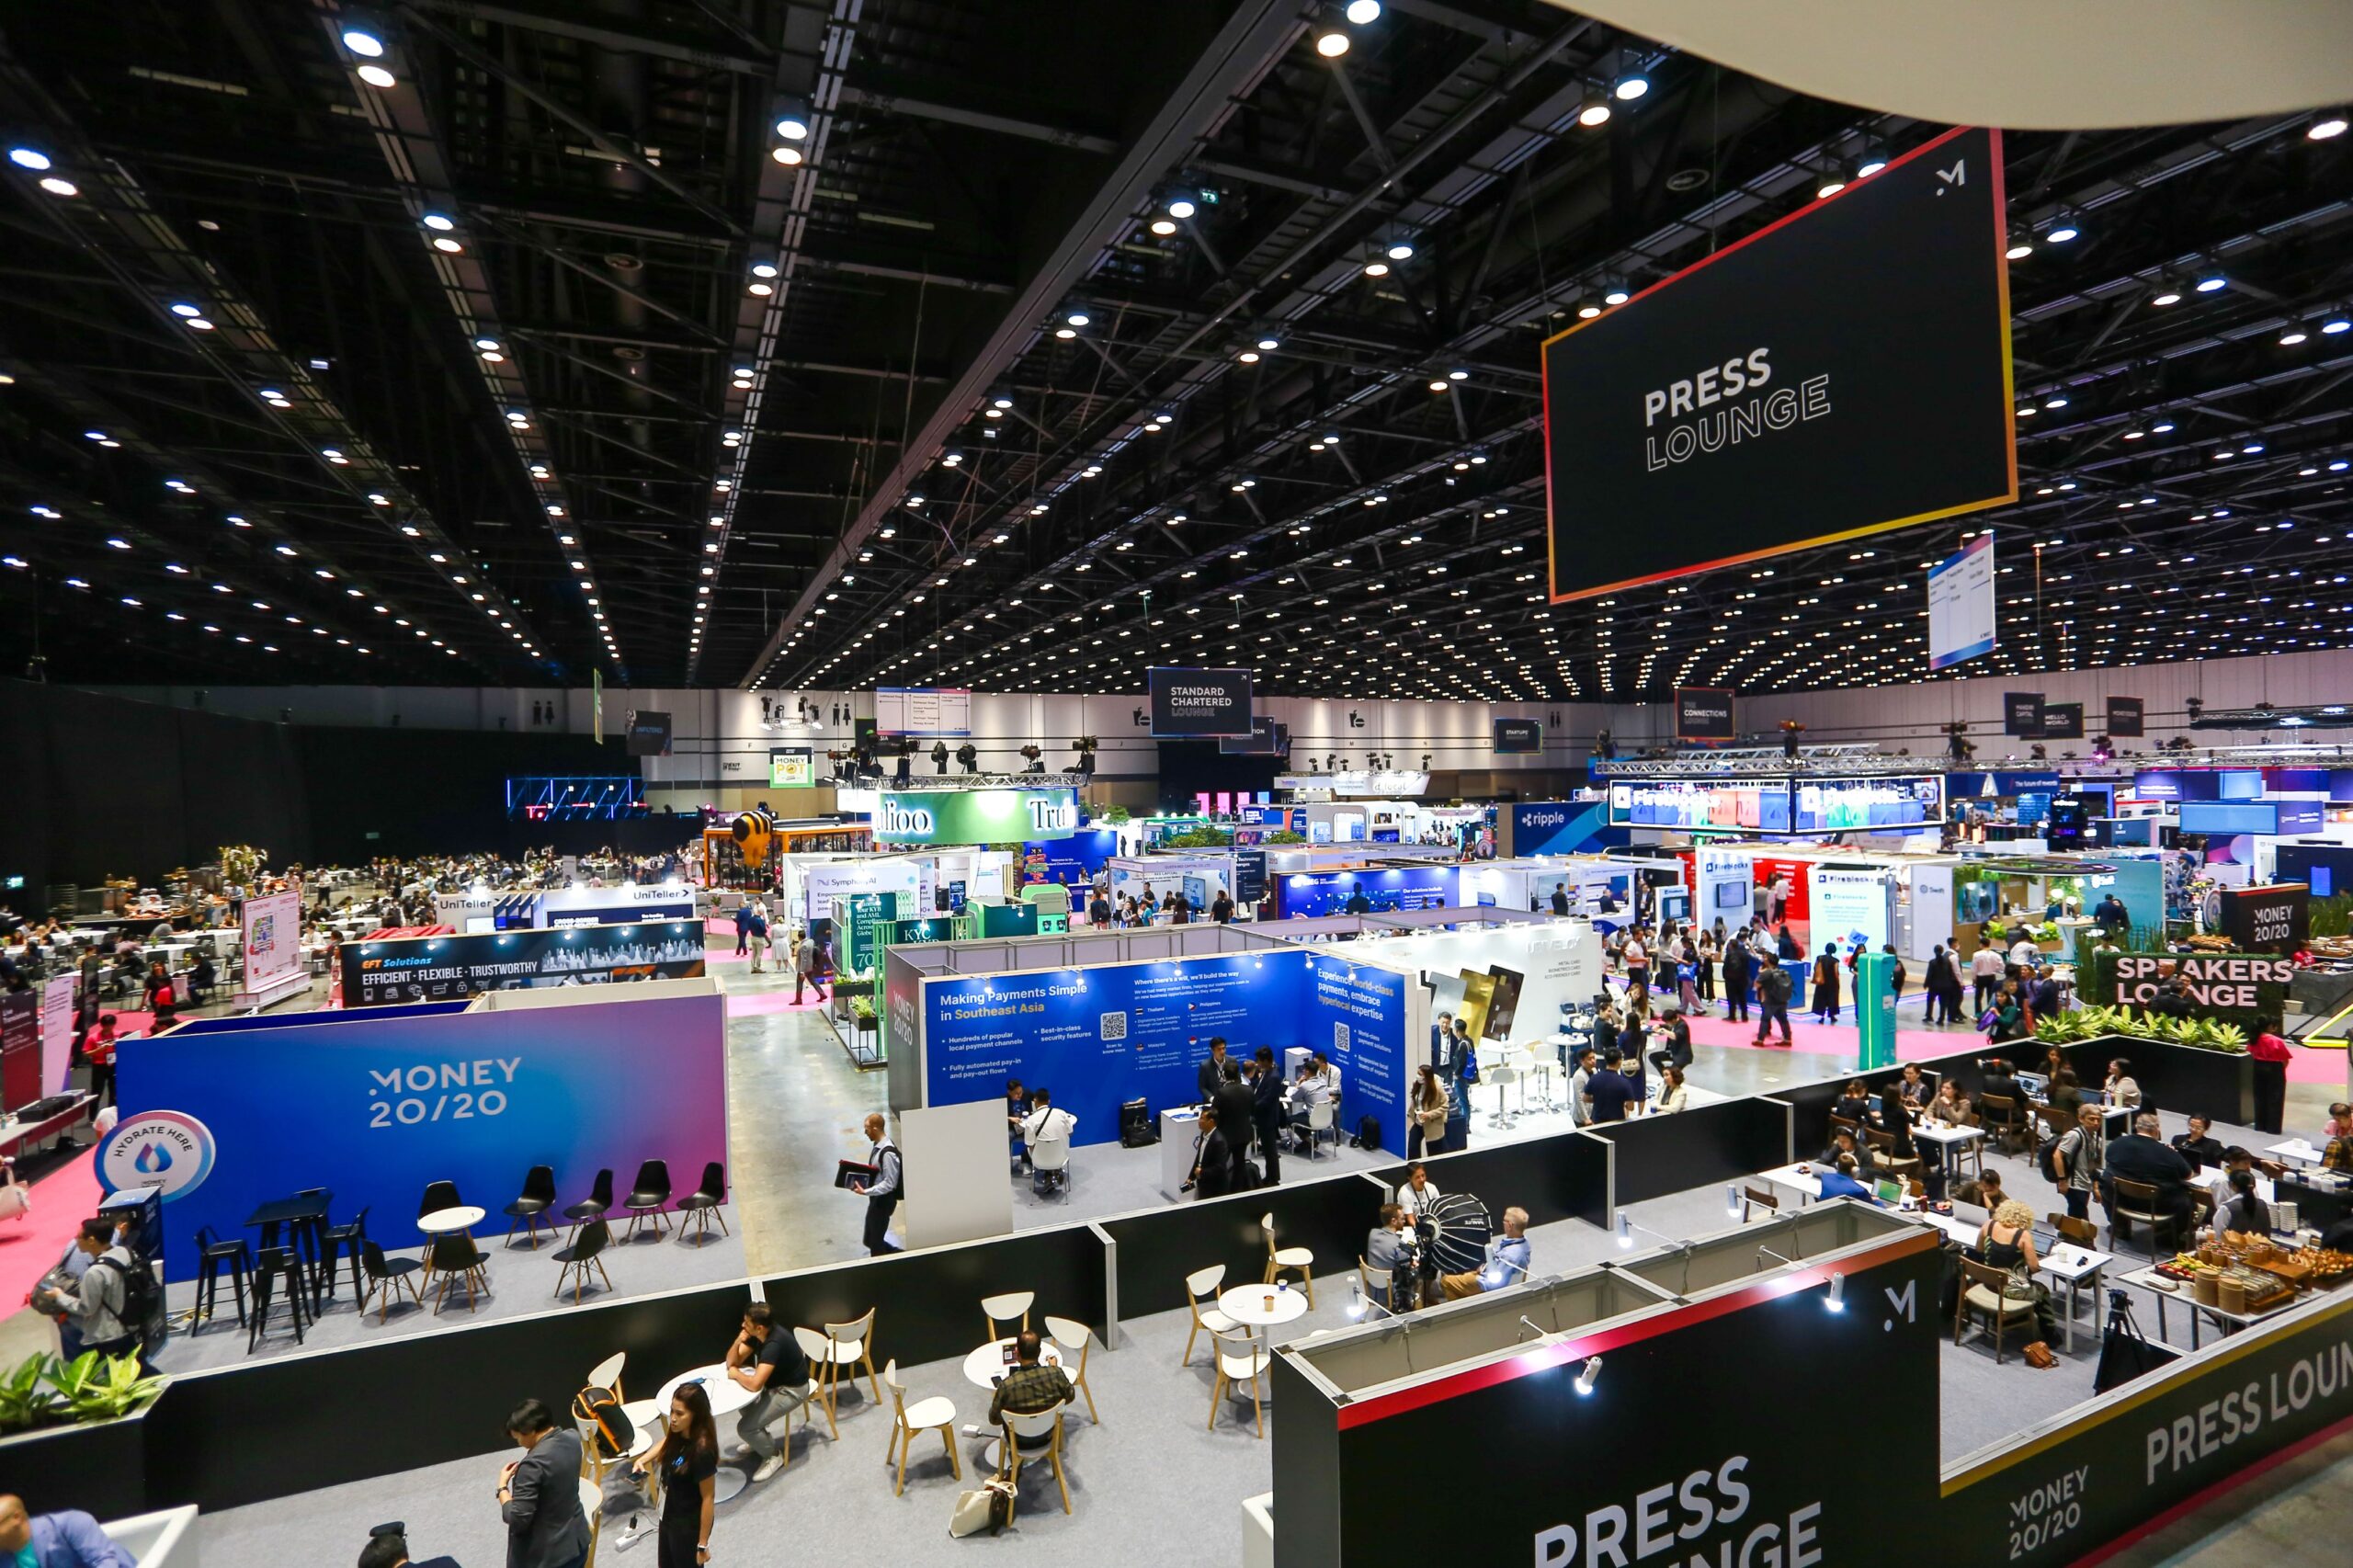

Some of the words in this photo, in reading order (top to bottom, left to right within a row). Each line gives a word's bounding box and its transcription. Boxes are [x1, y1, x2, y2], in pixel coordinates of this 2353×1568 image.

[1645, 347, 1771, 426] PRESS
[1646, 373, 1831, 472] LOUNGE
[1171, 687, 1224, 696] STANDARD
[1171, 698, 1232, 706] CHARTERED
[1171, 708, 1215, 717] LOUNGE
[776, 765, 805, 774] POT
[1632, 788, 1721, 807] Fireblocks
[1533, 811, 1564, 827] ripple
[1714, 863, 1748, 871] Fireblocks
[440, 898, 491, 910] UniTeller
[633, 889, 680, 902] UniTeller
[2255, 905, 2293, 925] MONEY
[904, 928, 930, 940] KYC
[2255, 923, 2290, 942] 20/20
[362, 959, 382, 969] EFT
[382, 956, 432, 968] Solutions
[362, 971, 413, 985] EFFICIENT
[418, 967, 462, 982] FLEXIBLE
[470, 961, 538, 978] TRUSTWORTHY
[1318, 968, 1352, 986] Experience
[1353, 979, 1395, 997] world-class
[940, 994, 985, 1006] Making
[988, 987, 1046, 1004] Payments
[1049, 984, 1087, 998] Simple
[1318, 982, 1349, 1000] payments,
[1351, 992, 1381, 1007] embrace
[2118, 983, 2257, 1006] LONGE
[893, 990, 915, 1024] MONEY
[941, 1009, 951, 1021] in
[955, 1005, 1017, 1020] Southeast
[1019, 1003, 1045, 1014] Asia
[1318, 994, 1351, 1011] hyperlocal
[1351, 1005, 1383, 1021] expertise
[894, 1013, 913, 1046] 20/20
[949, 1035, 981, 1044] Hundreds
[989, 1032, 1014, 1042] popular
[1040, 1024, 1081, 1035] Best-in-class
[1040, 1031, 1065, 1042] security
[1066, 1030, 1092, 1040] features
[964, 1041, 991, 1052] payment
[992, 1039, 1023, 1048] channels
[949, 1062, 967, 1073] Fully
[967, 1060, 1000, 1070] automated
[1001, 1057, 1022, 1067] pay-in
[949, 1071, 962, 1079] and
[963, 1068, 989, 1079] pay-out
[990, 1066, 1007, 1074] flows
[369, 1057, 522, 1096] MONEY
[369, 1090, 507, 1128] 20/20
[114, 1126, 165, 1157] HYDRATE
[166, 1127, 193, 1153] HERE
[2147, 1382, 2261, 1486] PRESS
[2009, 1465, 2088, 1528] MONEY
[1535, 1456, 1751, 1568] PRESS
[2009, 1503, 2081, 1561] 20/20
